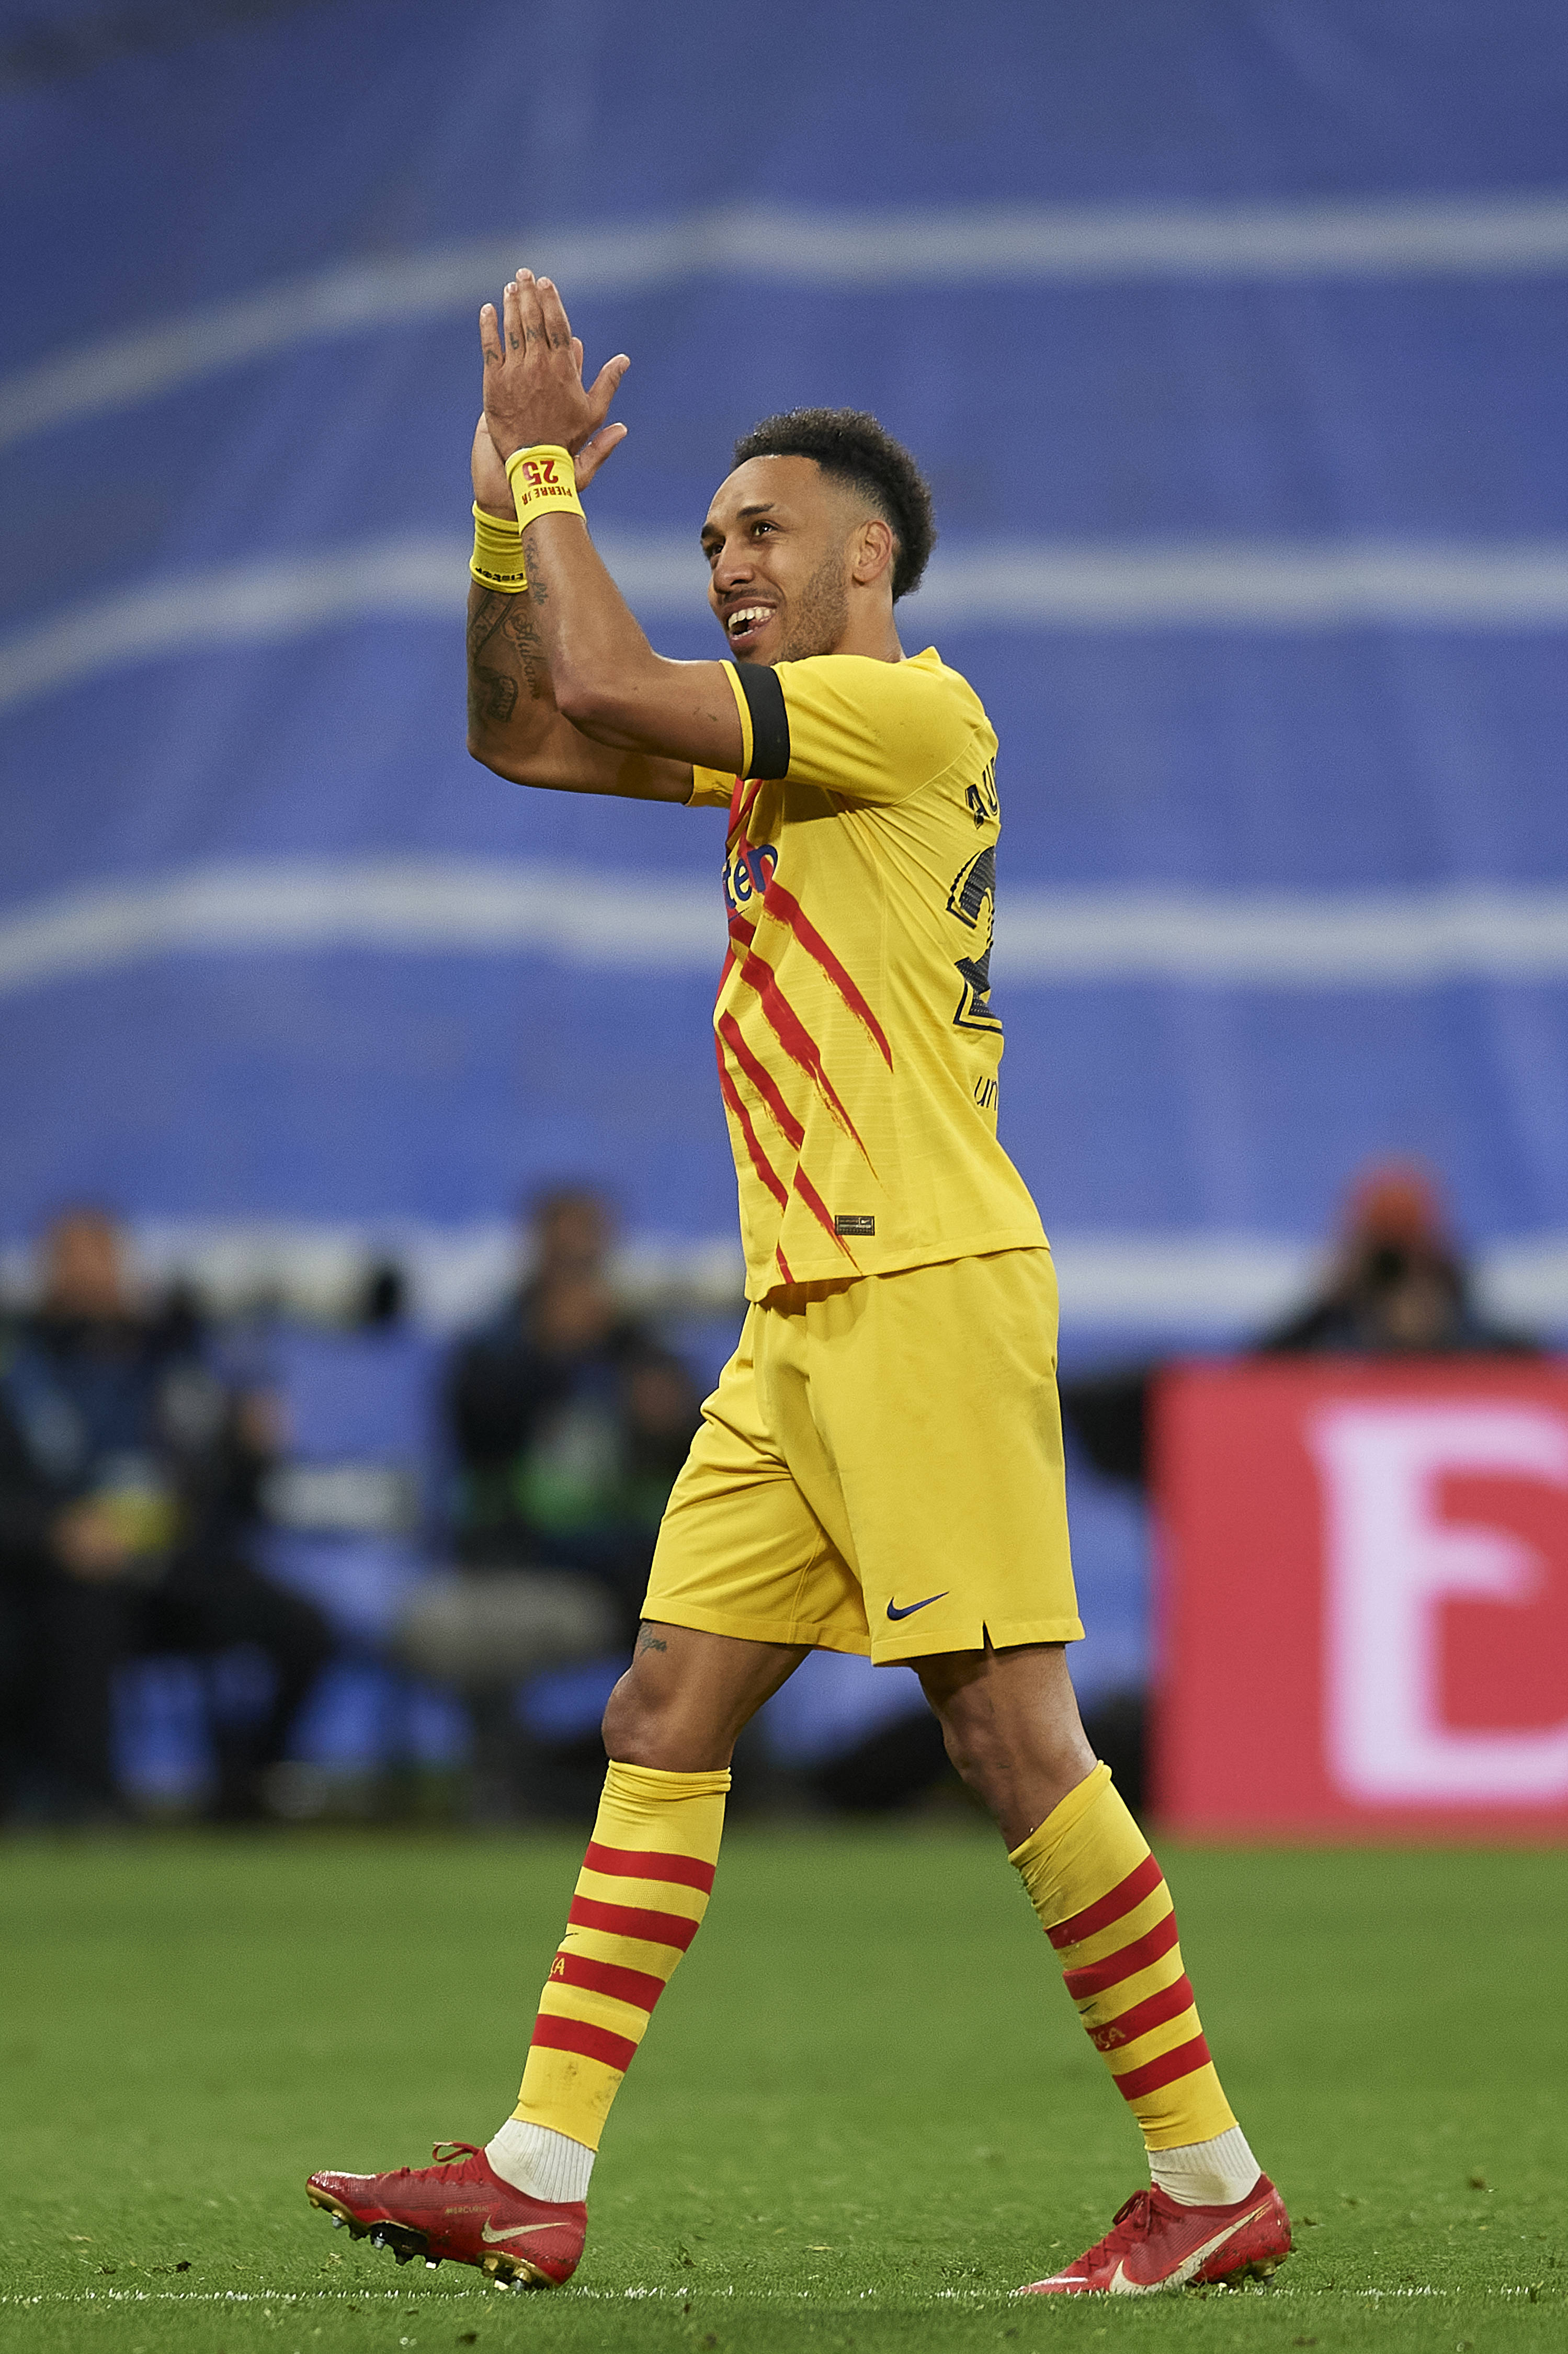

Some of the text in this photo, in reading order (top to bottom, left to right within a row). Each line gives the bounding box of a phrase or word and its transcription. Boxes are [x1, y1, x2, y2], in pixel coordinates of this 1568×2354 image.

[522, 460, 559, 487] 25
[522, 486, 572, 505] PIERRE JR
